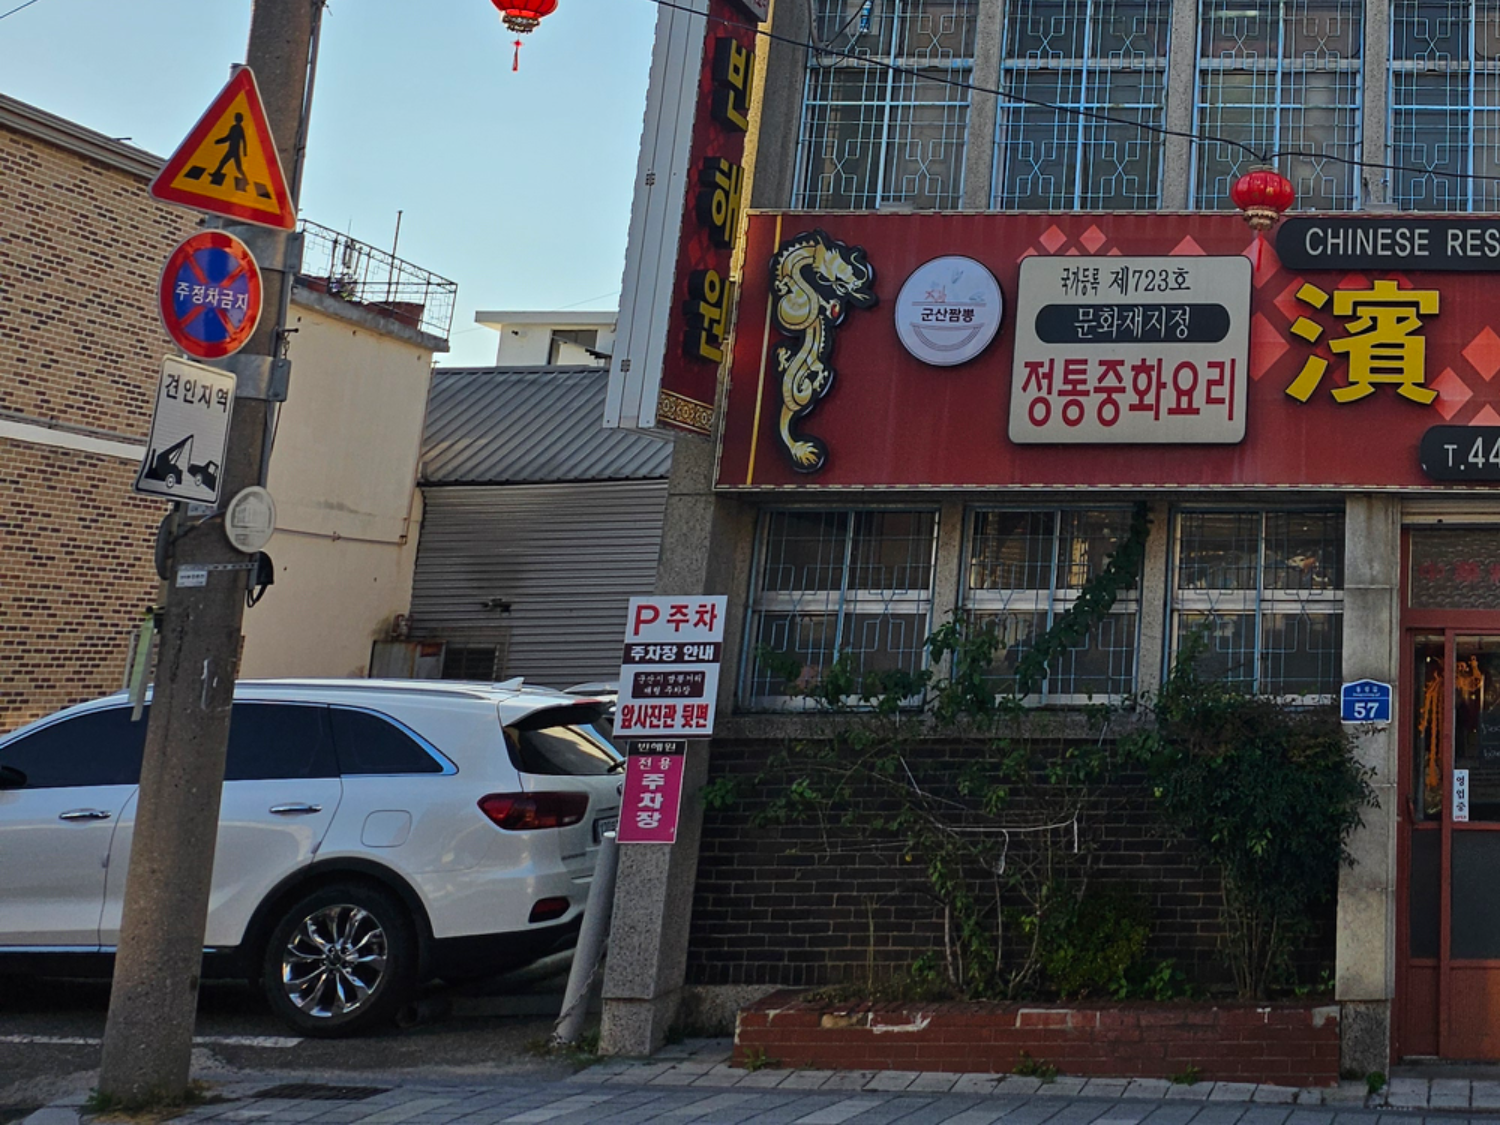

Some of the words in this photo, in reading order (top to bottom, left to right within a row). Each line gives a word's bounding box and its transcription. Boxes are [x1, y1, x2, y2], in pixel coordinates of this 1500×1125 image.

[699, 38, 756, 363] 빈해원
[1304, 226, 1430, 257] CHINESE
[175, 281, 249, 312] 주정차금지
[1060, 266, 1101, 297] 국가등록
[1108, 265, 1191, 297] 제723호
[921, 307, 975, 323] 군산짬뽕
[1073, 306, 1191, 340] 문화재지정
[164, 373, 230, 414] 견인지역
[1021, 357, 1237, 427] 정통중화요리
[633, 603, 661, 637] P
[666, 603, 718, 633] 주차
[630, 645, 678, 662] 주차장
[683, 644, 715, 661] 안내
[1353, 702, 1379, 718] 57
[635, 773, 665, 829] 주차장
